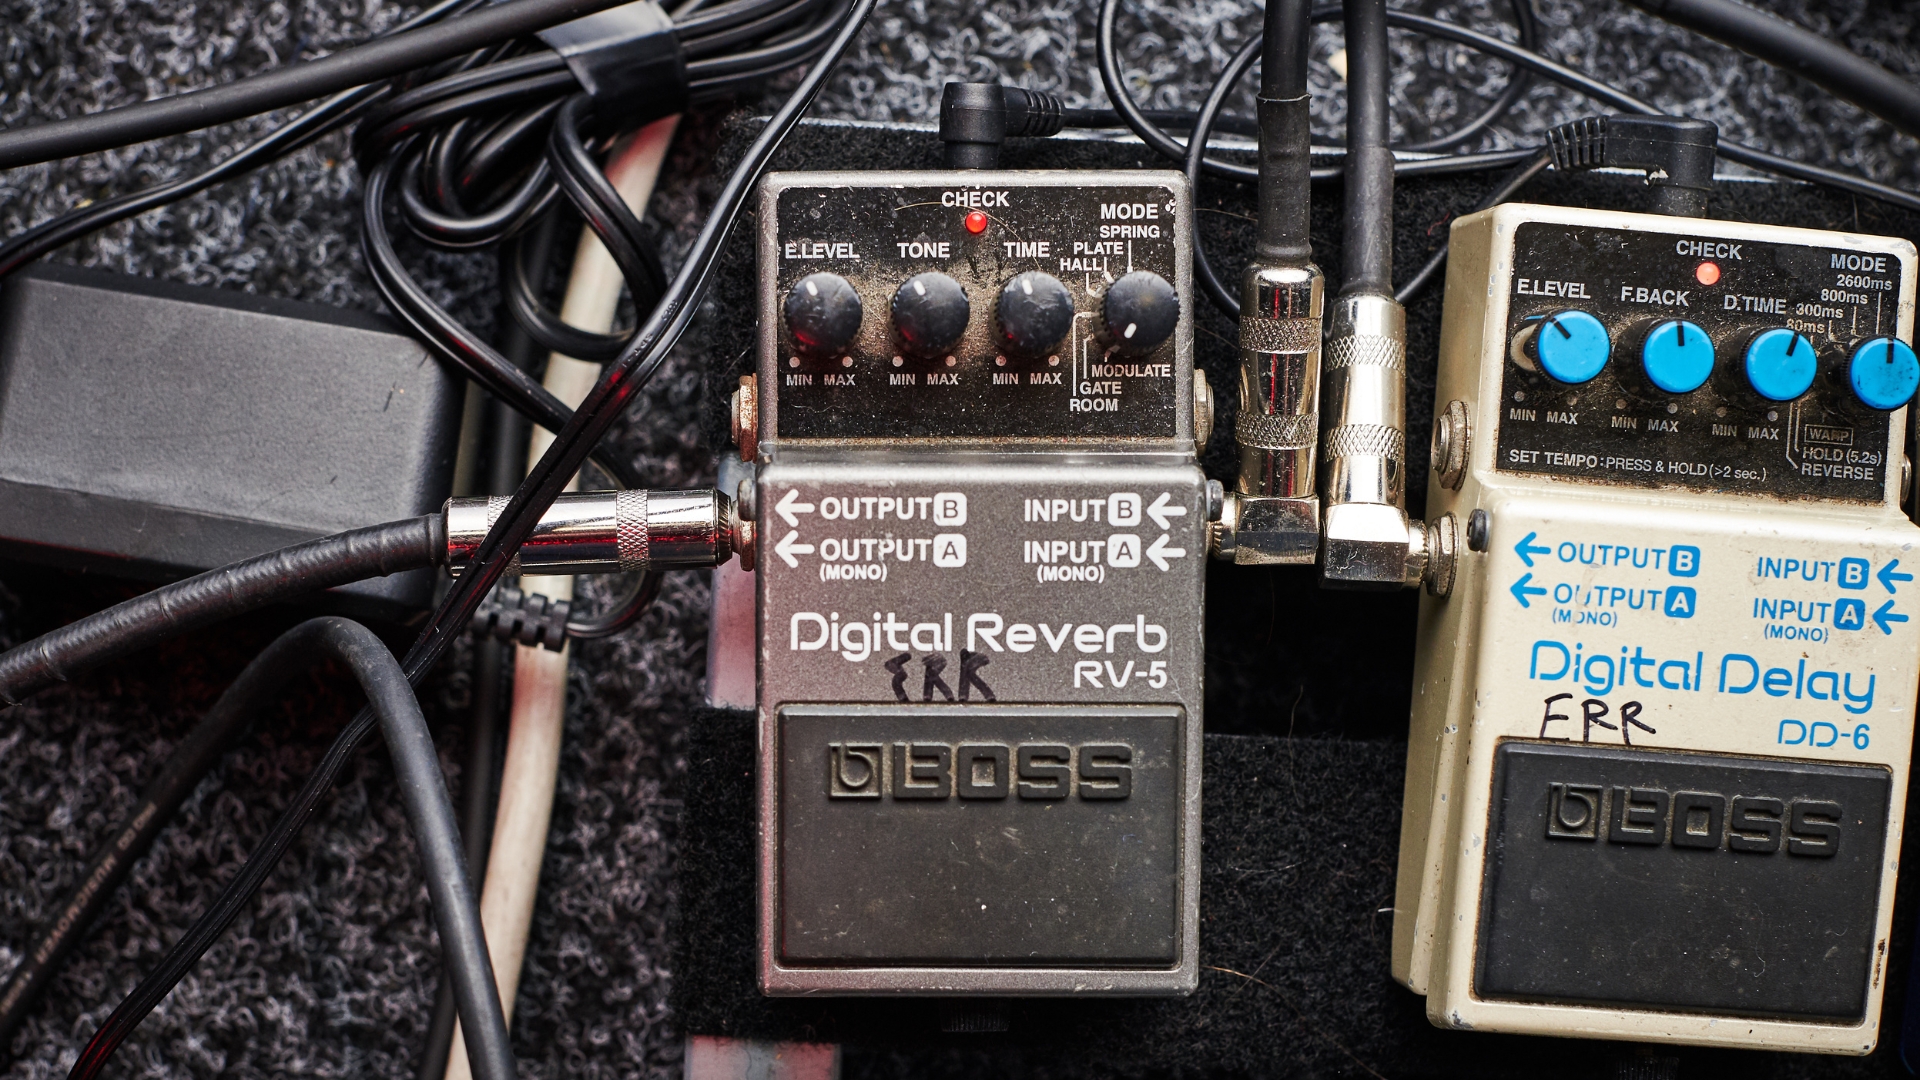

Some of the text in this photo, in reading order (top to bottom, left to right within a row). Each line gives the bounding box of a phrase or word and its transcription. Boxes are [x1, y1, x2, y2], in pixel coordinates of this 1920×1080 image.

[941, 191, 1010, 207] CHECK
[1100, 203, 1159, 220] MODE
[1100, 224, 1160, 239] SPRING
[785, 243, 860, 259] E.LEVEL
[897, 242, 950, 258] TONE
[1003, 242, 1050, 258] TIME
[1074, 242, 1124, 255] PLATE
[1676, 239, 1743, 261] CHECK
[1060, 258, 1102, 272] HALL
[1830, 253, 1887, 273] MODE
[1517, 278, 1591, 299] E.LEVEL
[1836, 273, 1893, 291] 2600ms
[1621, 286, 1690, 307] F.BACK
[1723, 295, 1787, 315] D.TIME
[1820, 288, 1869, 305] 800ms
[1795, 302, 1844, 319] 300ms
[1786, 318, 1825, 334] 80ms
[786, 373, 856, 386] MIN MAX
[889, 373, 958, 386] MIN MAX
[993, 372, 1062, 385] MIN MAX
[1091, 364, 1171, 378] MODULATE
[1079, 381, 1122, 396] GATE
[1069, 398, 1119, 412] ROOM
[1510, 408, 1579, 426] MIN MAX
[1611, 415, 1680, 433] MIN MAX
[1712, 424, 1779, 441] MIN MAX
[1809, 427, 1849, 441] WARP
[1509, 449, 1540, 463] SET
[1655, 460, 1665, 473] &
[1734, 467, 1767, 482] sec.)
[1802, 446, 1882, 467] HOLD (5.2s)
[1801, 462, 1874, 480] REVERSE
[820, 497, 932, 520] OUTPUT
[1024, 499, 1106, 522] INPUT
[820, 538, 932, 562] OUTPUT
[1024, 541, 1106, 564] INPUT
[1558, 541, 1667, 570] OUTPUT
[819, 564, 888, 582] (MONO)
[1036, 565, 1105, 584] (MONO)
[1757, 557, 1836, 583] INPUT
[1554, 583, 1662, 611] OUTPUT
[1552, 607, 1618, 628] (MONO)
[1753, 597, 1832, 623] INPUT
[790, 612, 1168, 662] Digital Reverb
[1764, 623, 1829, 644] (MONO)
[1073, 661, 1168, 689] RV-5
[1530, 640, 1876, 714] Digital Delay
[1777, 719, 1870, 750] DD-6
[892, 742, 1132, 800] BOSS
[1608, 784, 1844, 858] BOSS
